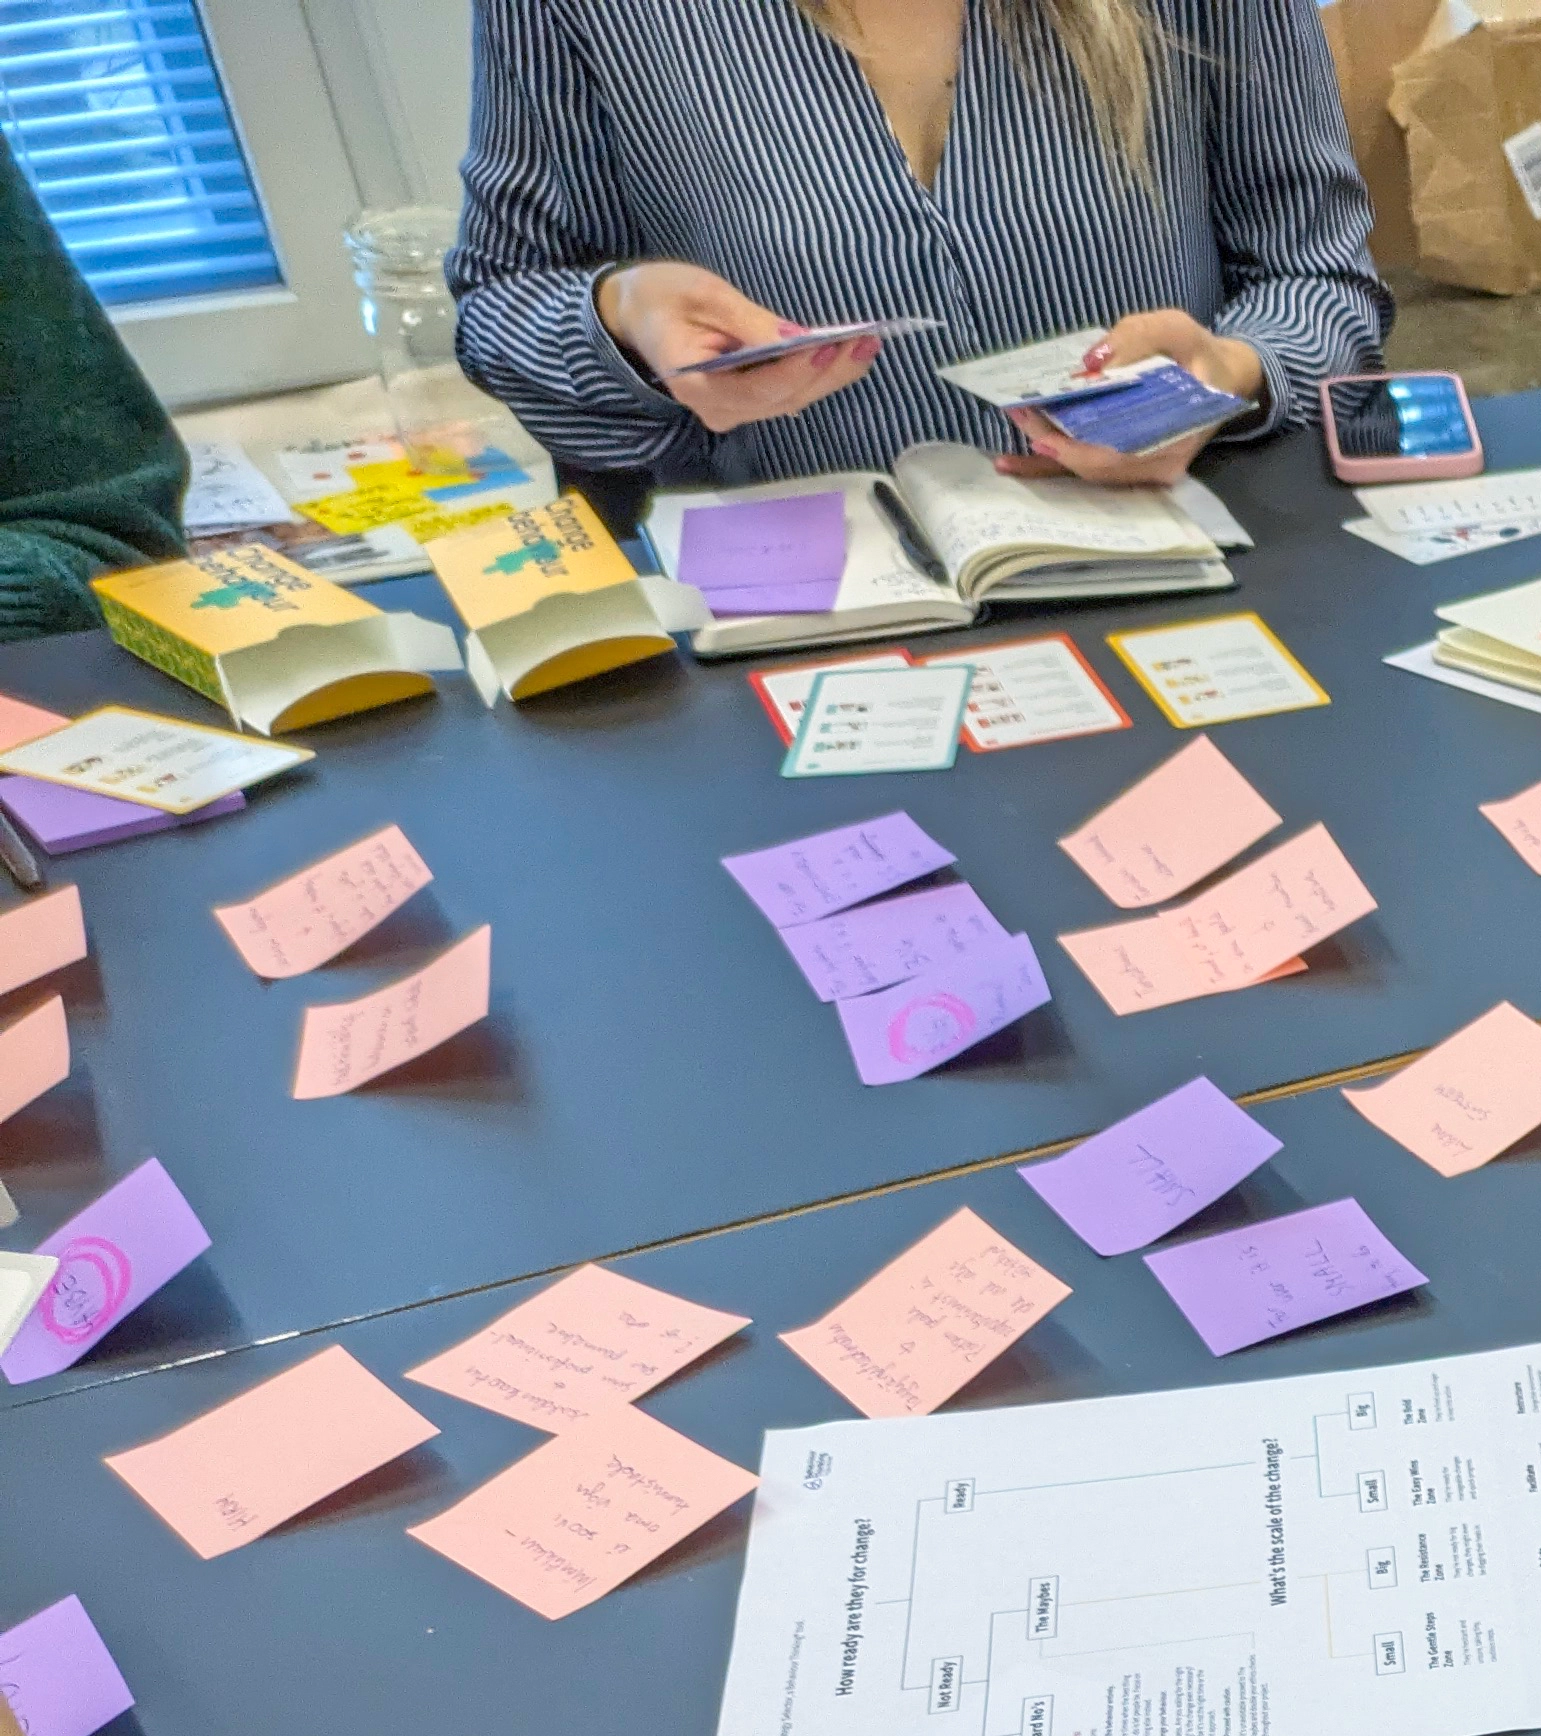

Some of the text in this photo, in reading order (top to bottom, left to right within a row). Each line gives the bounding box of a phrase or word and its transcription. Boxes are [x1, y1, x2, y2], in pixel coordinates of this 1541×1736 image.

[1355, 1403, 1371, 1417] Big
[952, 1482, 970, 1508] Ready
[1364, 1478, 1379, 1503] Small
[1261, 1437, 1287, 1606] What's the scale of the change?
[1374, 1559, 1391, 1574] Big
[834, 1518, 875, 1696] How ready are they for change?
[1034, 1581, 1052, 1633] The Maybes
[1380, 1640, 1396, 1666] Small
[936, 1660, 957, 1708] Not Ready
[1030, 1700, 1045, 1721] No's
